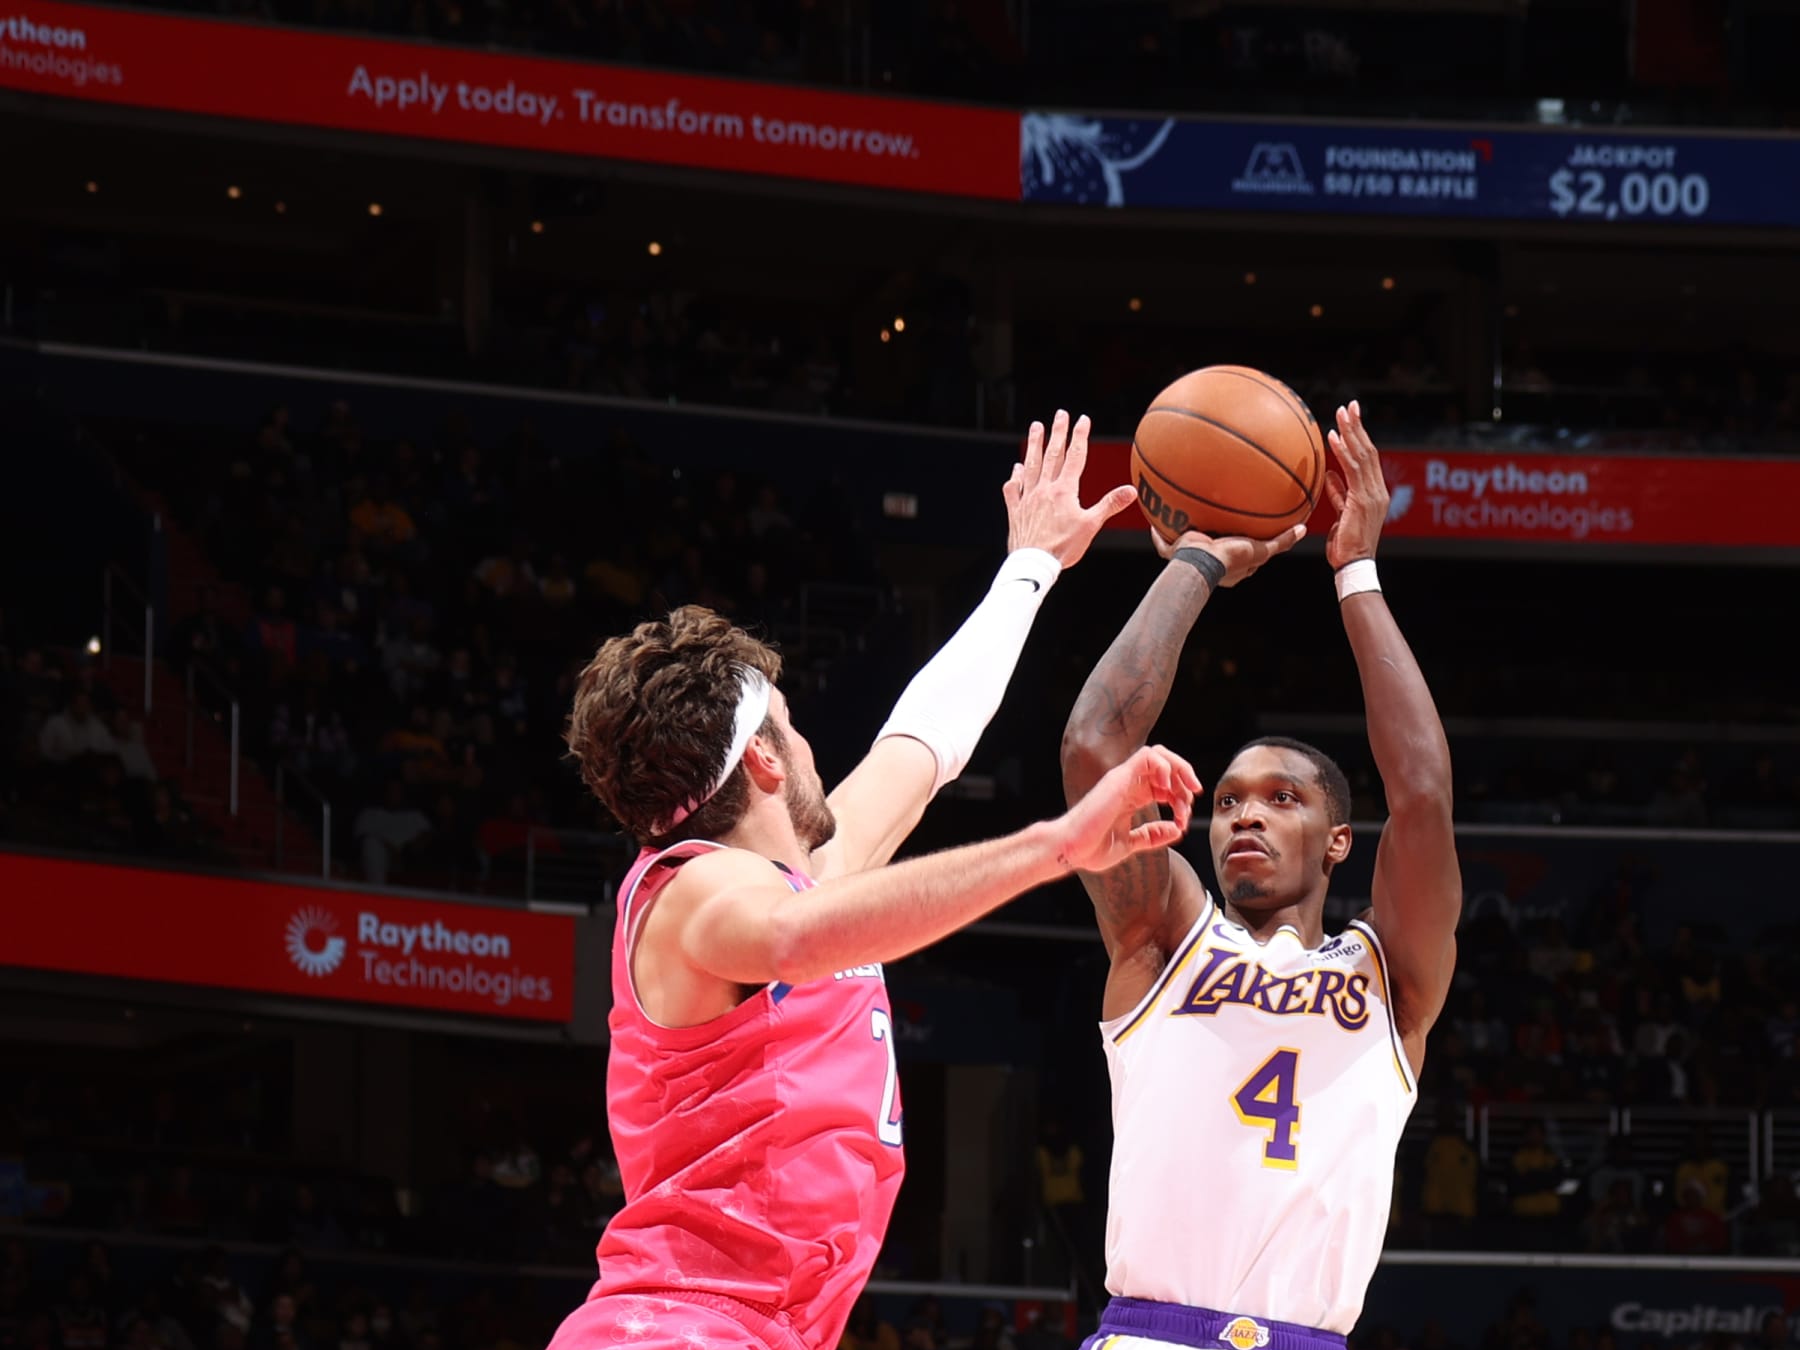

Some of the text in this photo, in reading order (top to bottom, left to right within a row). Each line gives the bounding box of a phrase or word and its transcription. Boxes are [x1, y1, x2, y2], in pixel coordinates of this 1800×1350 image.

[347, 64, 920, 160] Apply today. Transform tomorrow.
[1324, 145, 1476, 172] FOUNDATION
[1567, 144, 1676, 169] JACKPOT
[1323, 171, 1394, 198] 50/50
[1398, 174, 1478, 200] RAFFLE
[1549, 168, 1710, 221] $2,000
[1425, 459, 1588, 498] Raytheon
[1425, 496, 1633, 540] Technologies
[357, 911, 510, 959] Raytheon
[357, 950, 553, 1006] Technologies
[1170, 947, 1370, 1033] LAKERS
[1229, 1046, 1302, 1171] 4
[1610, 1302, 1755, 1339] Capital
